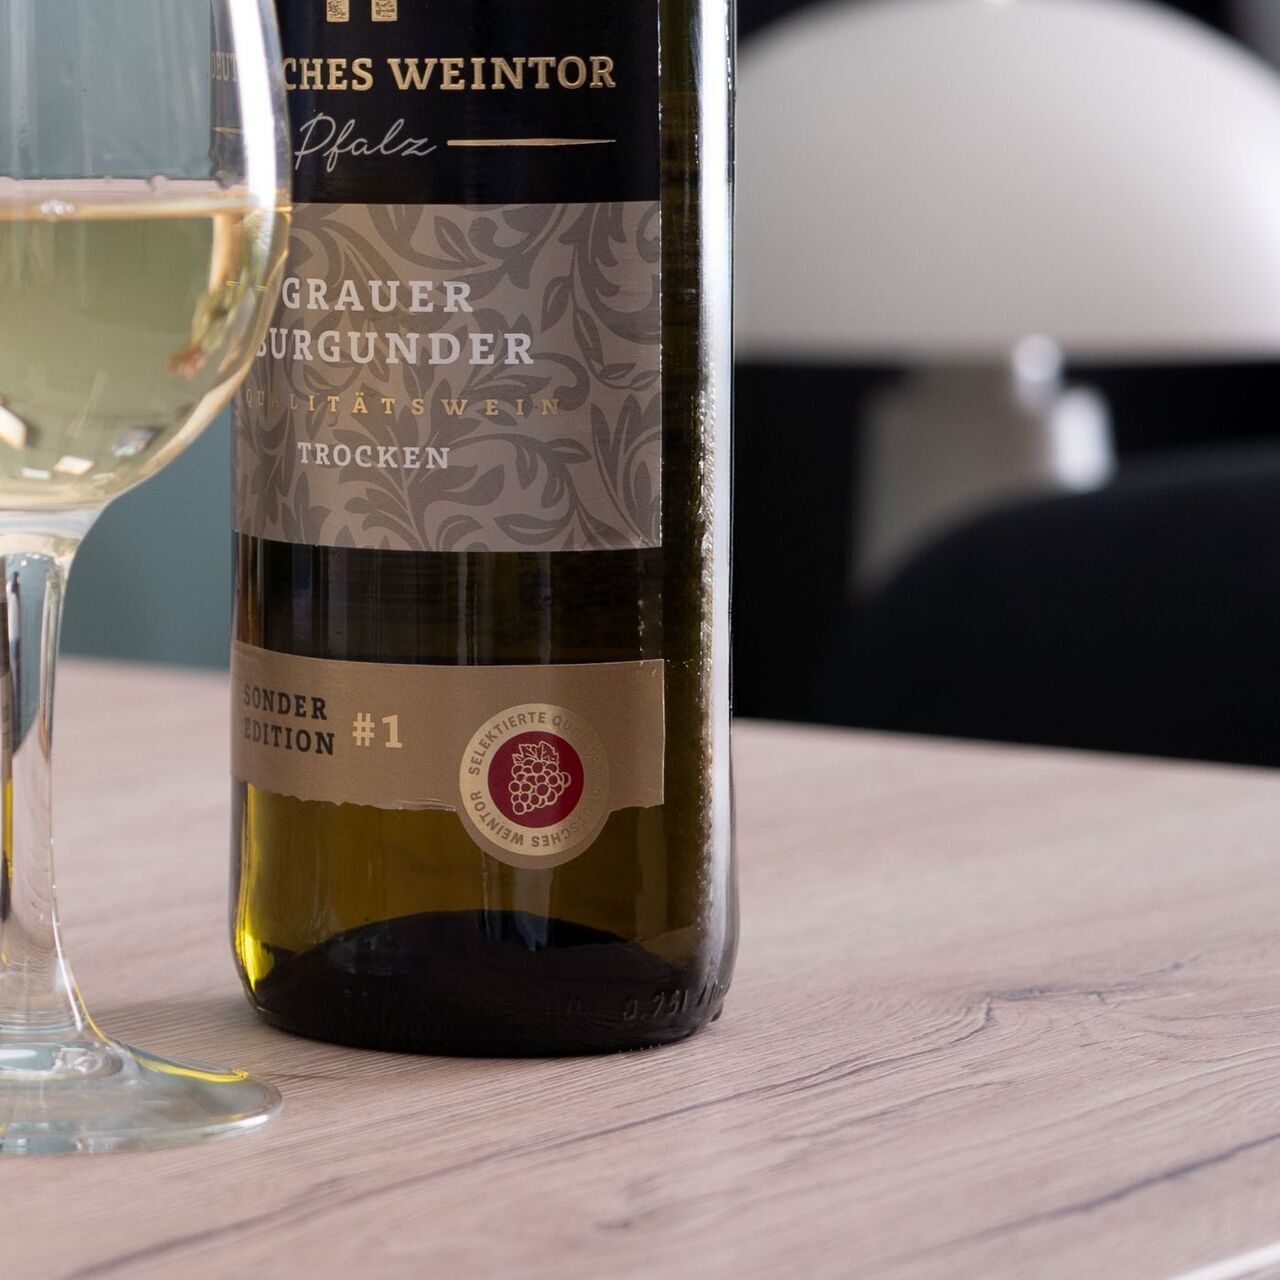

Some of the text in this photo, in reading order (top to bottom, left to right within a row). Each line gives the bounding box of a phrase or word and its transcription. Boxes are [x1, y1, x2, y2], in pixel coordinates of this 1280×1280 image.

[387, 56, 616, 90] WEINTOR
[294, 112, 438, 173] Pfalz
[282, 277, 473, 313] GRAUER
[297, 442, 450, 470] TROCKEN
[243, 683, 328, 721] SONDER
[243, 717, 335, 756] EDITION
[352, 712, 403, 749] #1
[468, 711, 547, 776] SELEKTIERTE
[470, 790, 524, 847] WEINTOR
